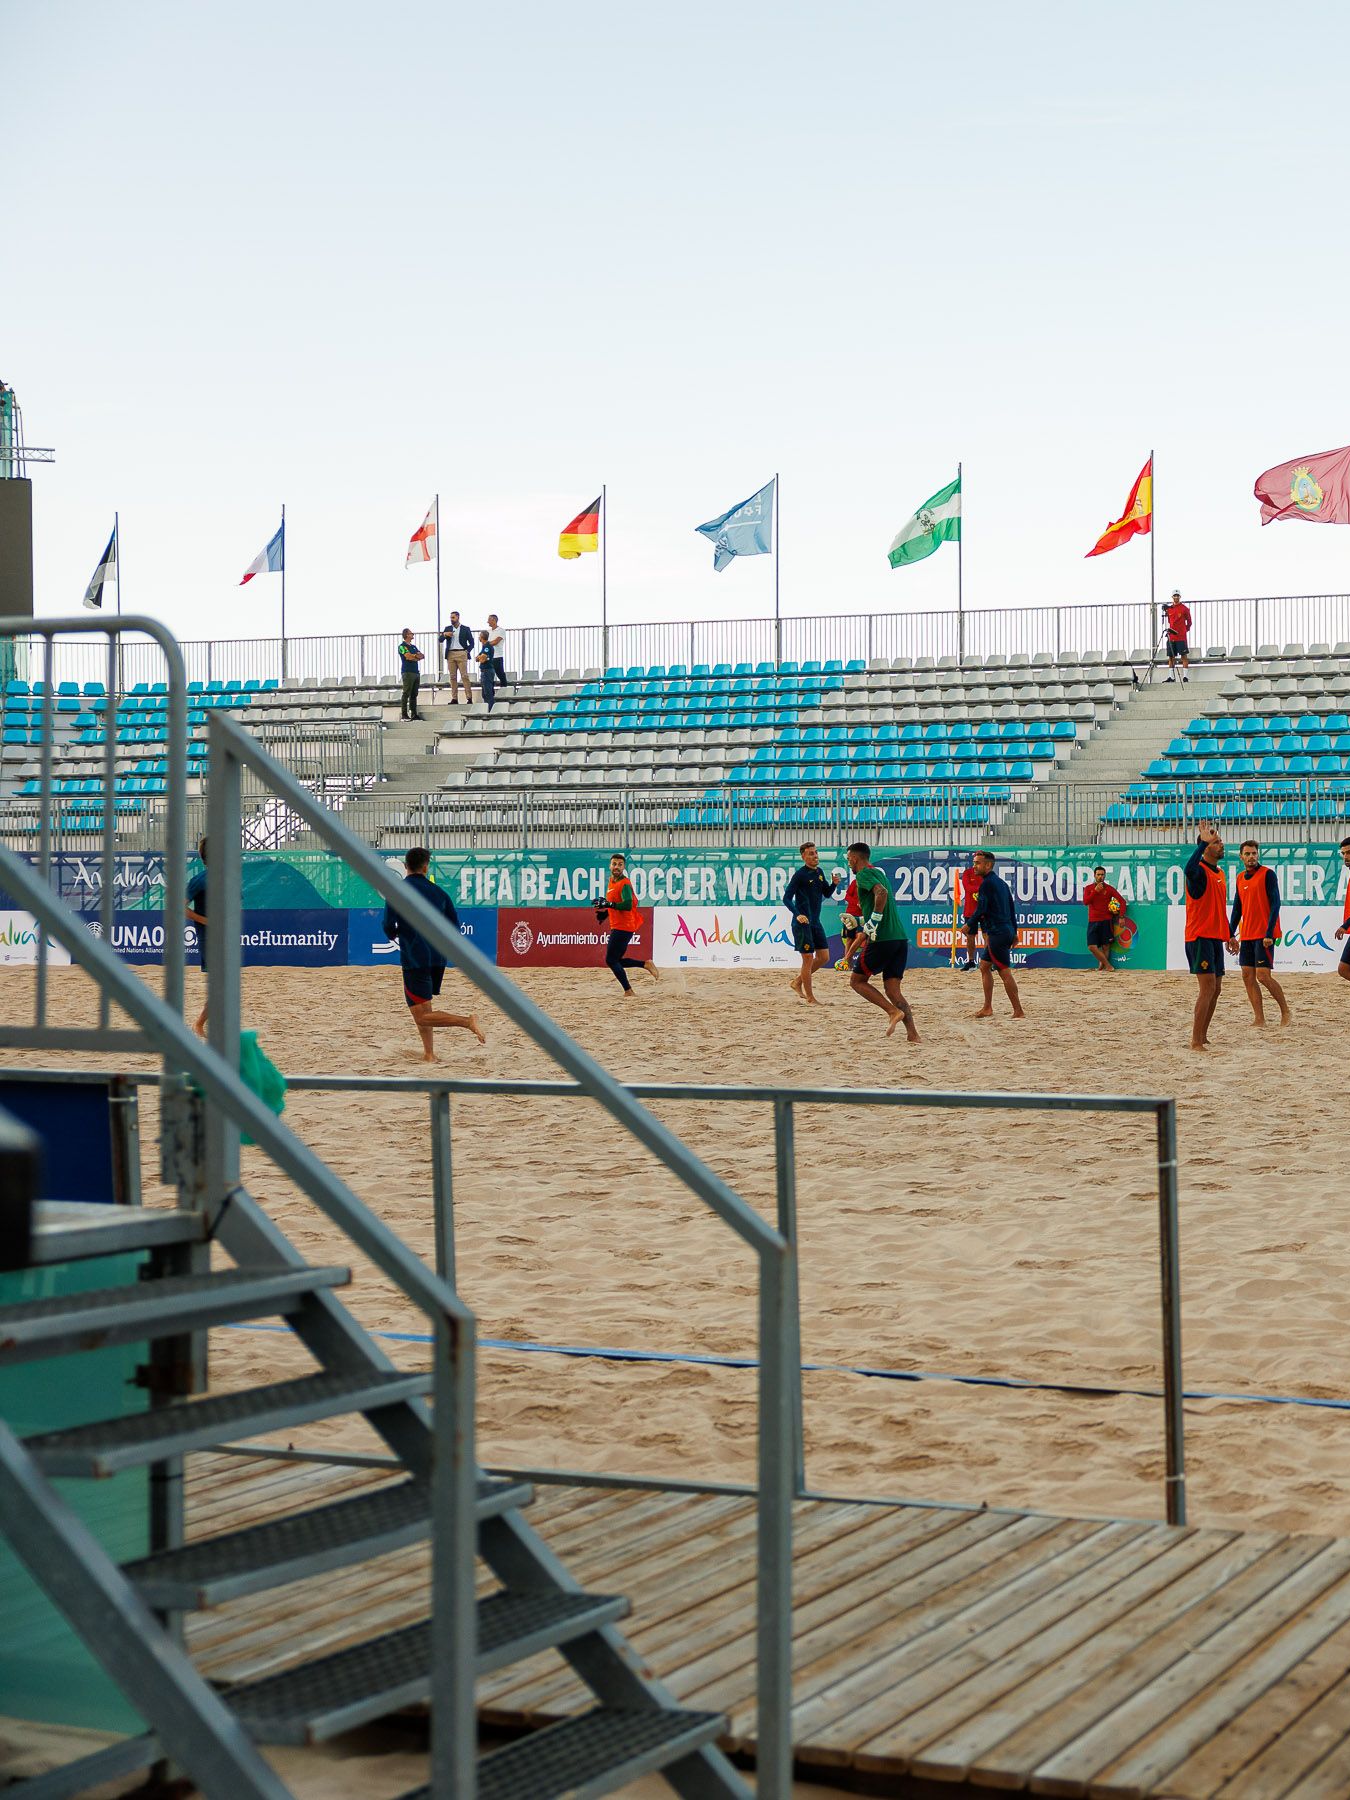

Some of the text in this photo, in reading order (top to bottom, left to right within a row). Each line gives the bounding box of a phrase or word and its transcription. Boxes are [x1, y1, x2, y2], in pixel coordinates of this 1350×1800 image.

[73, 859, 168, 889] Analucía
[460, 868, 514, 901] FIFA
[521, 868, 605, 901] BEACH
[623, 867, 717, 901] OCCER
[725, 867, 796, 901] WOR
[911, 914, 930, 925] FIFA
[1026, 914, 1044, 925] CUP
[1046, 914, 1068, 925] 2025
[111, 926, 165, 946] UNAO
[240, 930, 338, 950] neHumanity
[536, 932, 611, 947] Ayuntamiento de
[672, 914, 795, 949] Andalucía
[921, 930, 1055, 946] EUROPEN LIFIER
[1009, 951, 1027, 964] ÁDIZ
